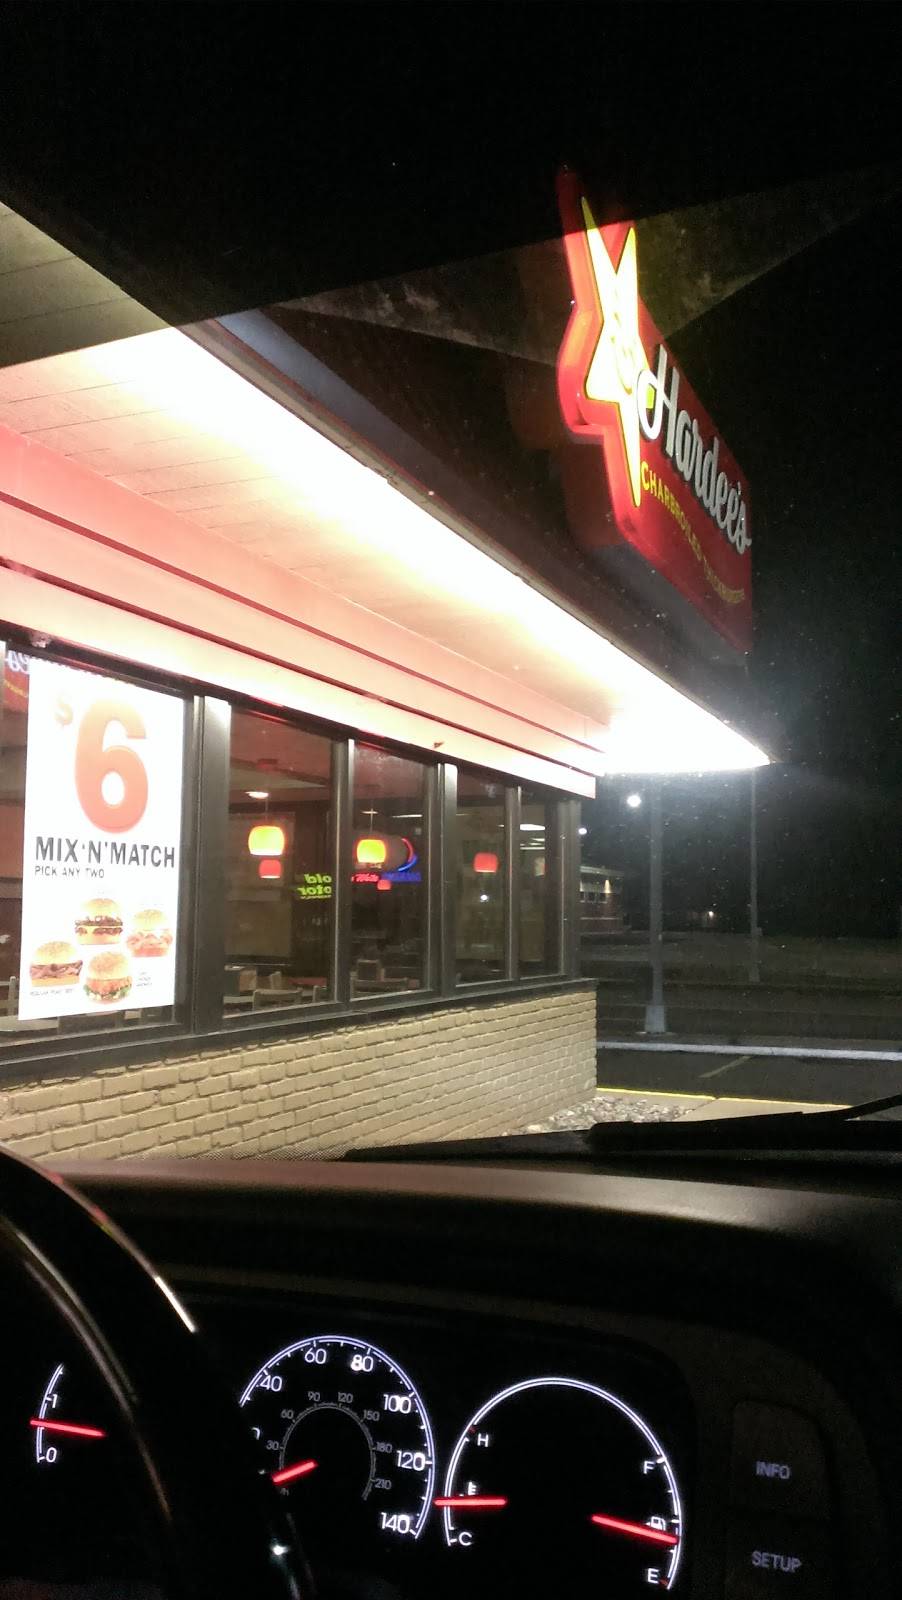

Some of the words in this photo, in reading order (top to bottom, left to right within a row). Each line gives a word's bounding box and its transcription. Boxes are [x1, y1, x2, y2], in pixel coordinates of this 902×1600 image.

[637, 344, 752, 555] Hardee's
[34, 865, 57, 877] PICK
[62, 867, 80, 878] ANY
[85, 868, 105, 879] TWO
[304, 1347, 327, 1365] 60
[350, 1354, 374, 1372] 80
[260, 1376, 283, 1392] 40
[307, 1391, 321, 1402] 90
[337, 1391, 354, 1403] 120
[383, 1393, 412, 1415] 100
[280, 1409, 294, 1420] 60
[362, 1409, 380, 1421] 150
[265, 1440, 279, 1451] 30
[375, 1441, 392, 1454] 180
[477, 1434, 490, 1448] H
[46, 1447, 58, 1463] 0
[396, 1450, 426, 1472] 120
[643, 1461, 655, 1474] F
[756, 1460, 791, 1480] INFO
[374, 1478, 392, 1490] 210
[381, 1512, 411, 1535] 140
[458, 1531, 473, 1547] C
[751, 1550, 803, 1573] SETUP
[647, 1568, 660, 1584] E
